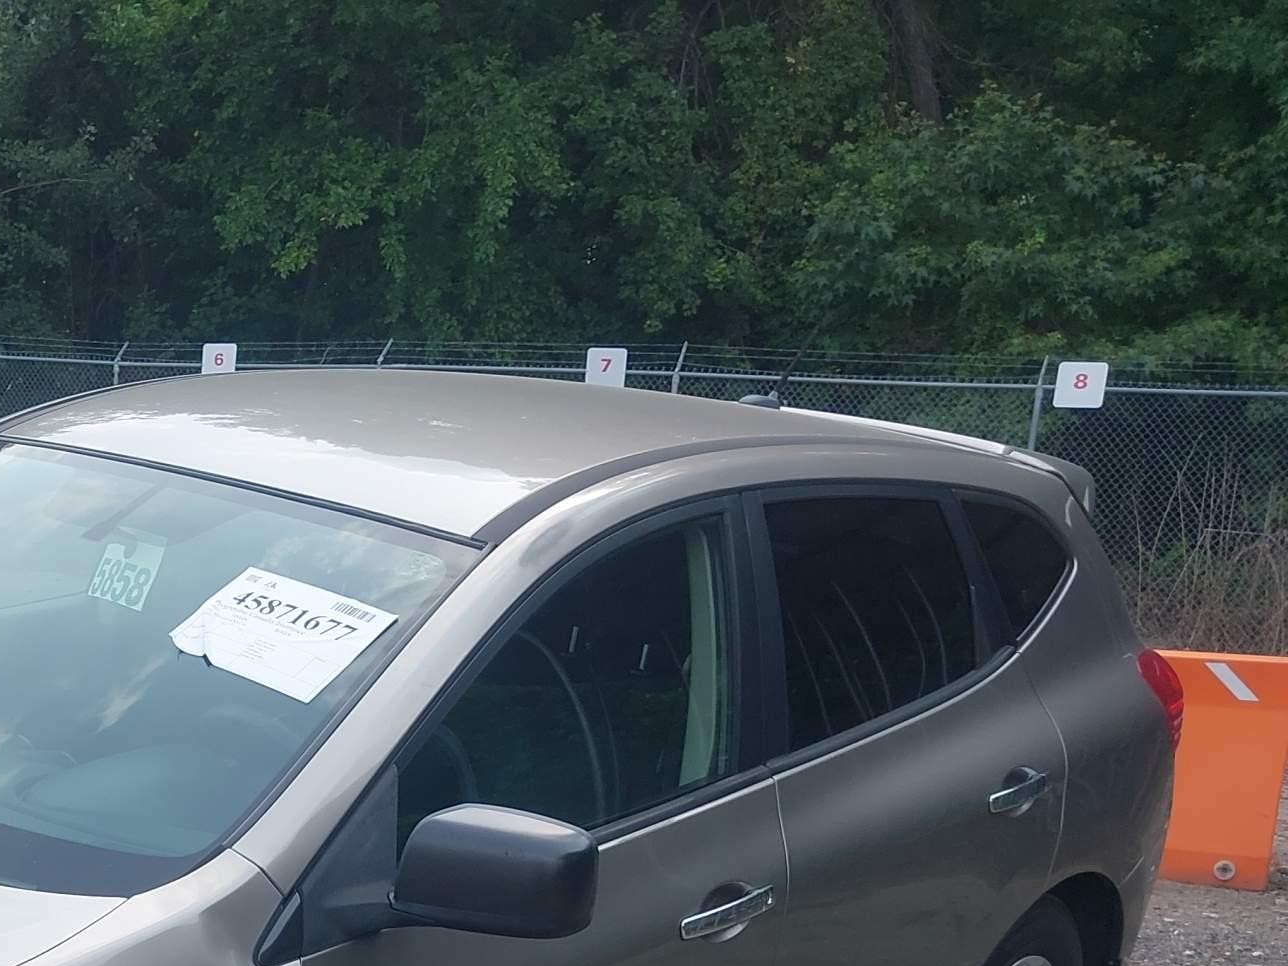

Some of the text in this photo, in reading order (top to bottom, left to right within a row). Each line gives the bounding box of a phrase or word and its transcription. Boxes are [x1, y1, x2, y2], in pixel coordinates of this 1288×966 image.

[214, 353, 224, 366] 6
[600, 359, 612, 372] 7
[1073, 374, 1089, 390] 8
[91, 557, 152, 606] 5858
[233, 591, 359, 641] 45871677
